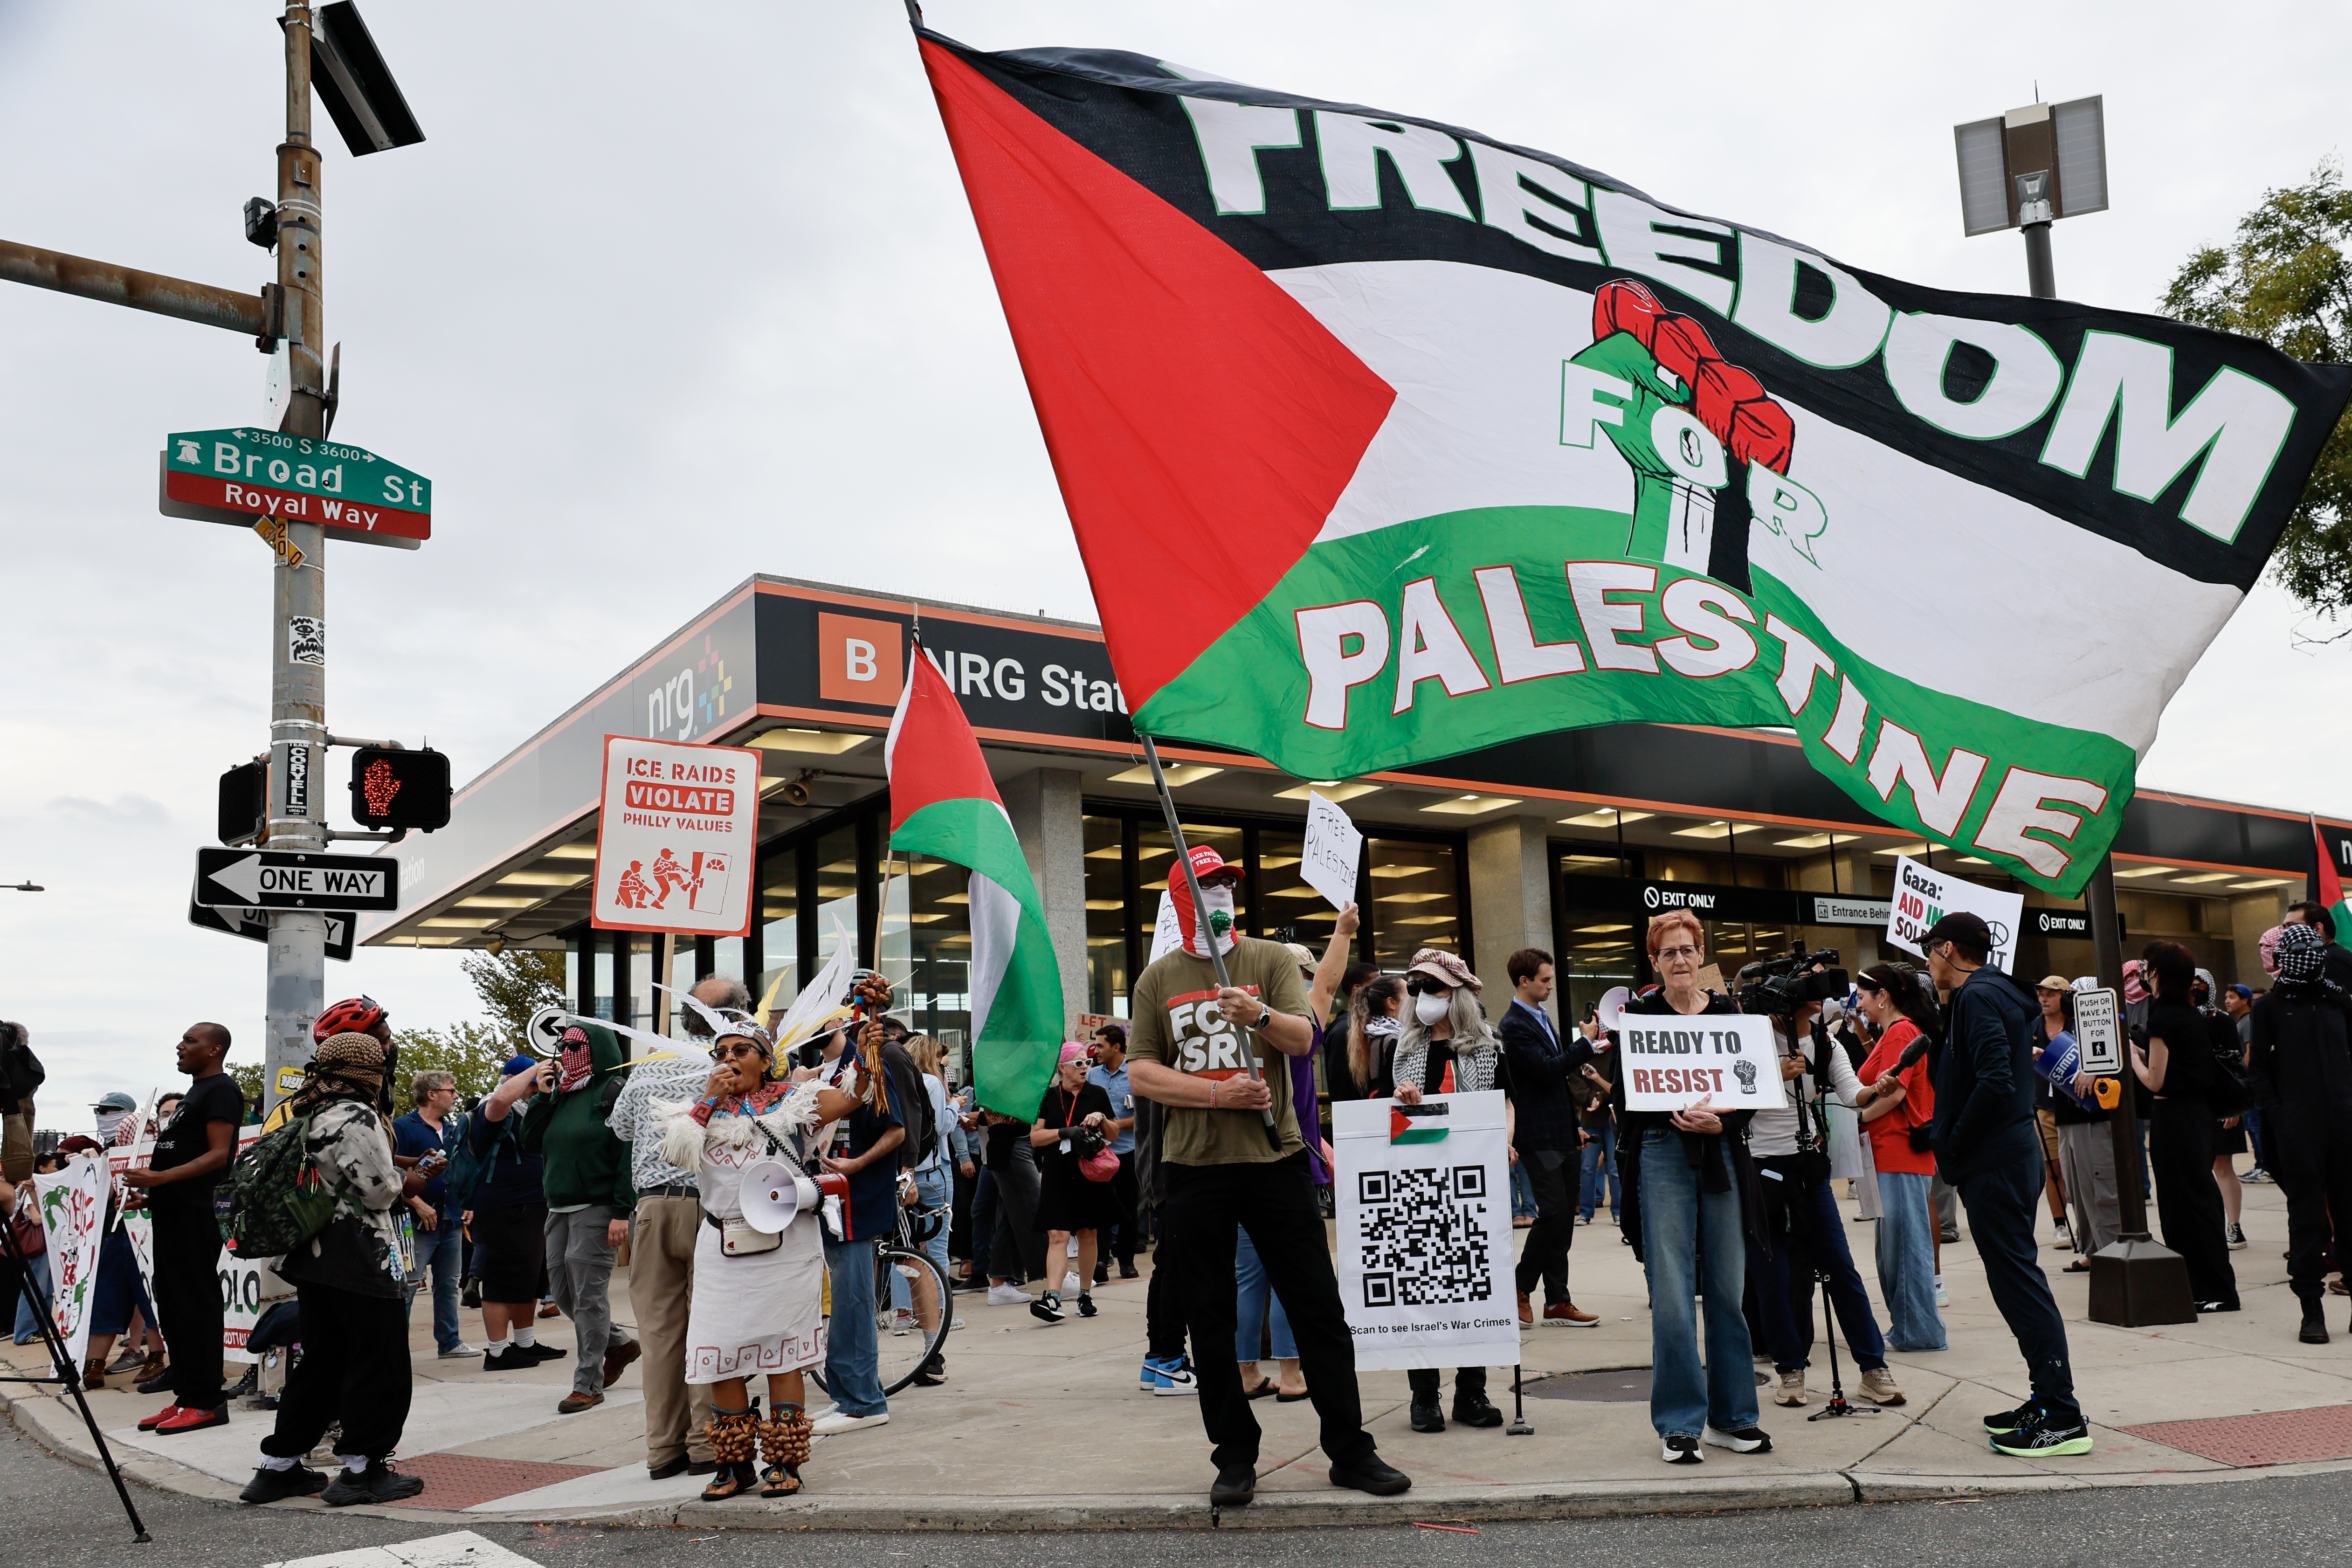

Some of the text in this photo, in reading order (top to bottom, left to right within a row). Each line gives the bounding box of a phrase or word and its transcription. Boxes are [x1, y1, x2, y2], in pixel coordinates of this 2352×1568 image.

[1177, 93, 2297, 545] FREEDOM
[251, 432, 360, 461] 3500 S 3600
[214, 442, 423, 506] Broad St
[1559, 359, 1828, 571] FOR
[225, 483, 379, 531] Royal Way
[846, 637, 877, 682] B
[1042, 663, 1128, 715] Stat
[648, 668, 694, 741] nrg
[1293, 558, 2108, 880] PALESTINE
[290, 747, 306, 805] CORYELL
[627, 757, 736, 785] I.C.E. RAIDS
[630, 784, 731, 812] VIOLATE
[623, 812, 733, 833] PHILLY VALUES
[1317, 808, 1345, 843] FREE
[1195, 857, 1212, 867] FREE
[1307, 824, 1356, 889] PALESTINE
[260, 868, 378, 894] ONE WAY
[400, 856, 425, 892] tation
[1903, 864, 1943, 901] Gaza:
[1662, 891, 1716, 909] EXIT ONLY
[1832, 905, 1890, 919] Entrance Behin
[1898, 891, 1924, 920] AID
[2051, 918, 2085, 931] EXIT ONLY
[1081, 1014, 1107, 1027] LET
[2080, 1009, 2100, 1017] WAVE
[2083, 1019, 2111, 1028] BUTTON
[1628, 1029, 1742, 1054] READY TO
[1633, 1068, 1724, 1093] RESIST
[1741, 1084, 1756, 1092] PEACE
[834, 1133, 850, 1141] ALESTINE
[1350, 1325, 1375, 1335] Scan
[1378, 1325, 1388, 1333] to
[1411, 1321, 1448, 1332] Israel's
[1451, 1320, 1471, 1330] War
[1474, 1318, 1511, 1328] Crimes
